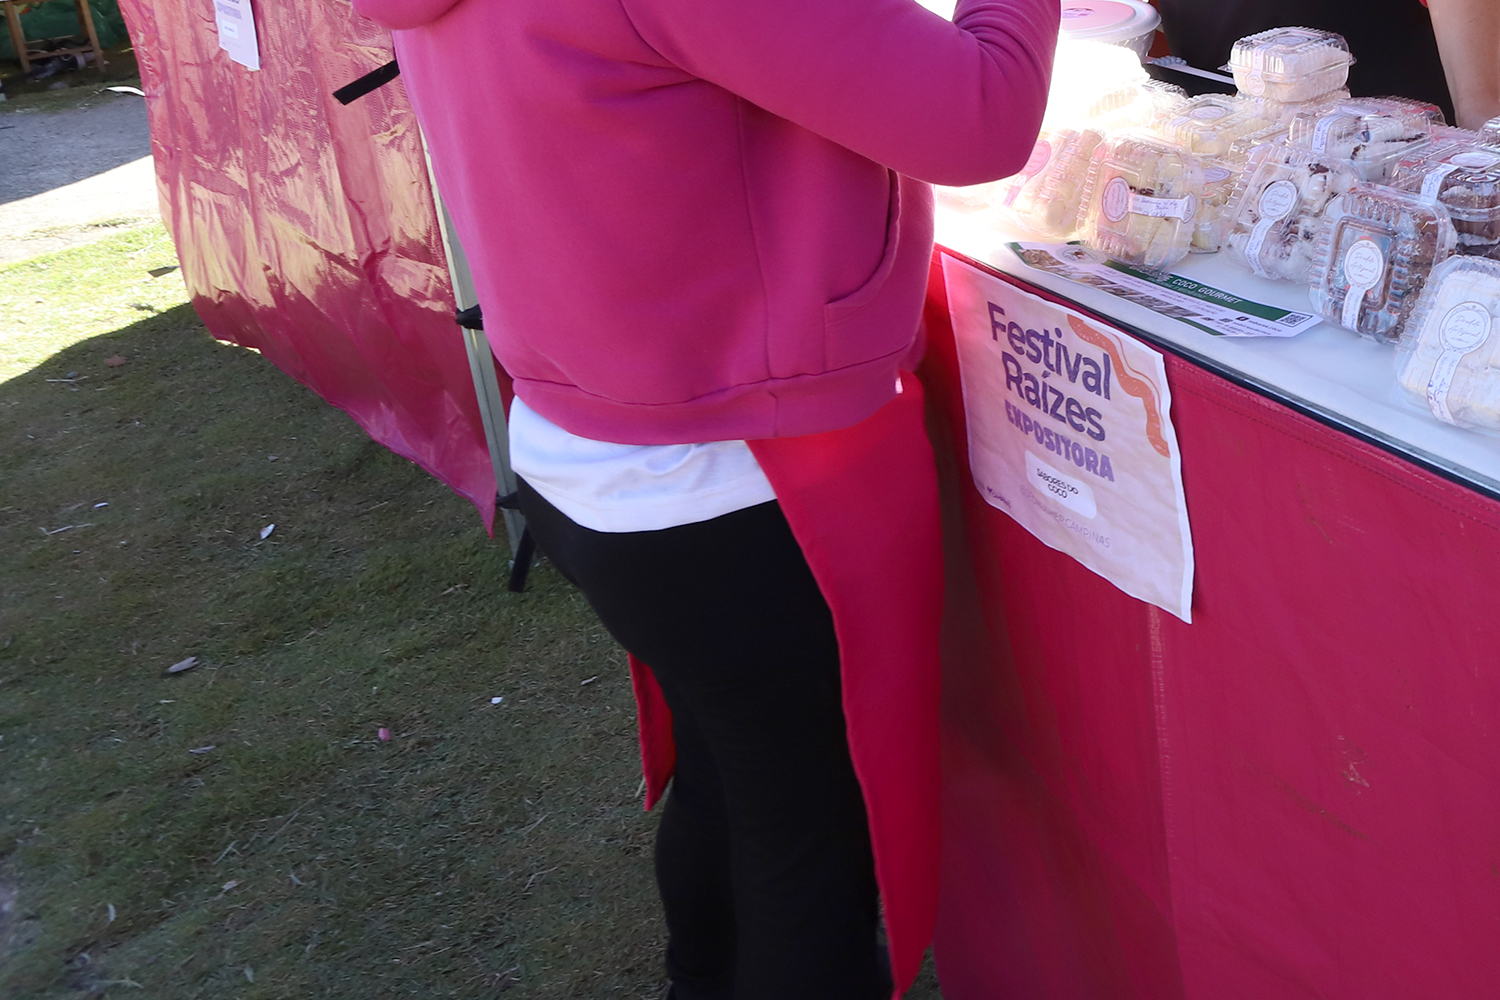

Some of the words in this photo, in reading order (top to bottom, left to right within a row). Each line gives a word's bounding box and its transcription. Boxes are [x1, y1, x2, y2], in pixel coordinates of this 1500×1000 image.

[1172, 278, 1198, 290] COCO
[1198, 286, 1243, 305] GOURMET
[987, 301, 1111, 401] Festival
[1001, 351, 1106, 442] Raízes
[1004, 399, 1115, 483] EXPOSITORA
[1047, 483, 1068, 499] COCO
